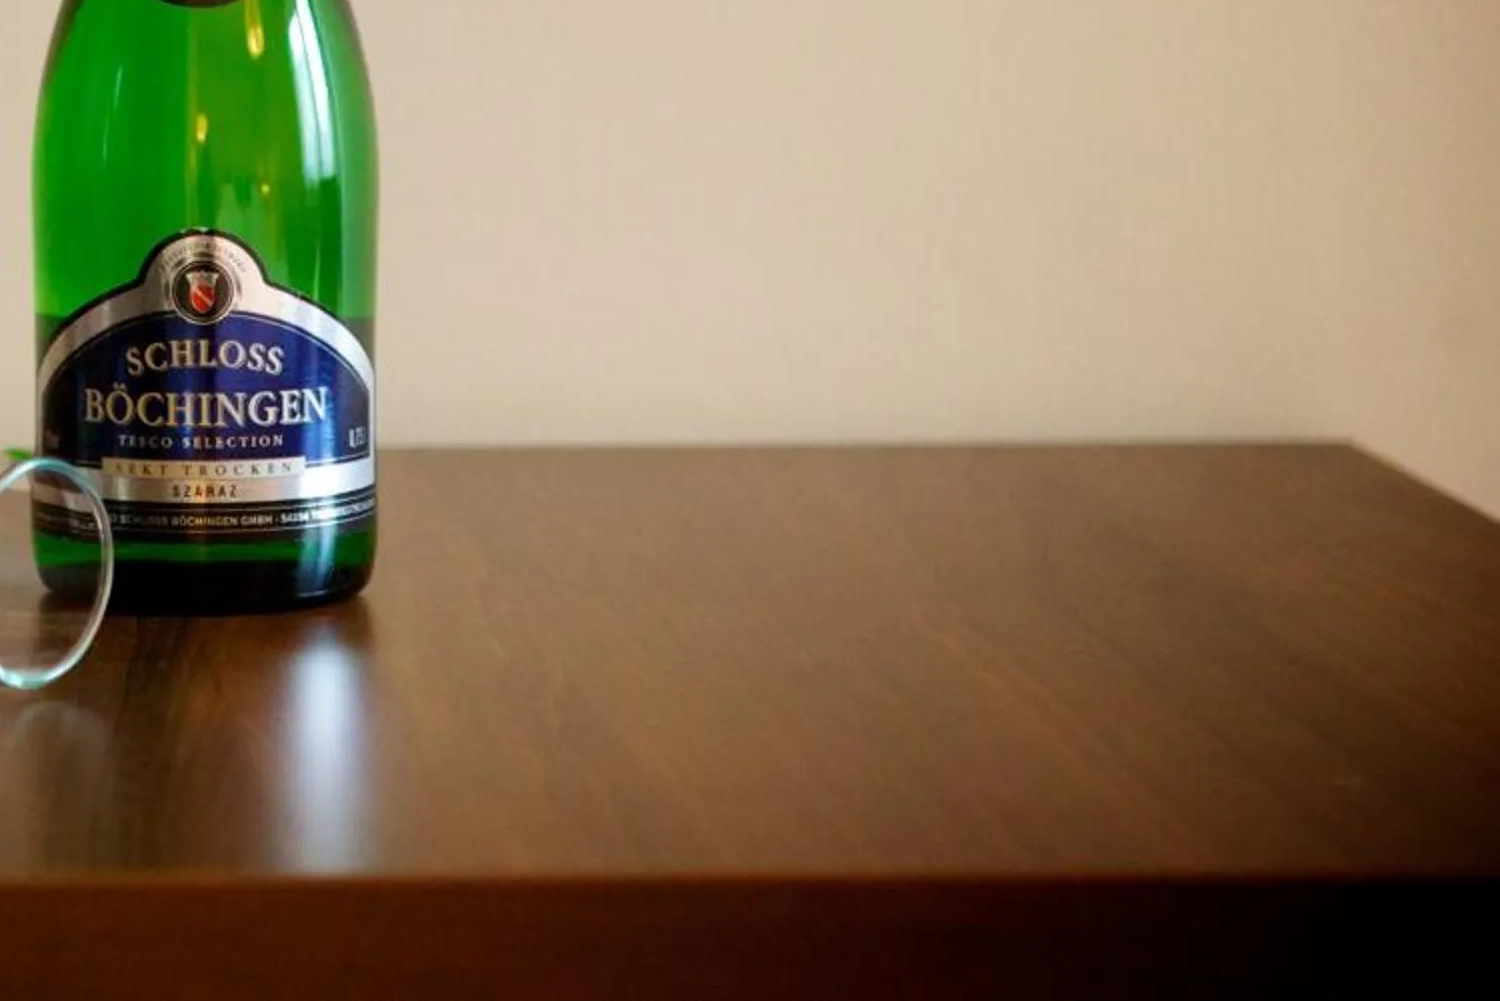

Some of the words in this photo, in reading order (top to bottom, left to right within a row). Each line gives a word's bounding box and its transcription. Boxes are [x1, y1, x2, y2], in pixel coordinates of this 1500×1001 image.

[125, 338, 285, 377] SCHLOSS
[84, 382, 329, 428] BÖCHINGEN
[117, 433, 174, 449] TESCO
[181, 433, 284, 450] SELECTION
[114, 462, 169, 476] SEKT
[181, 461, 294, 477] TROCKEN
